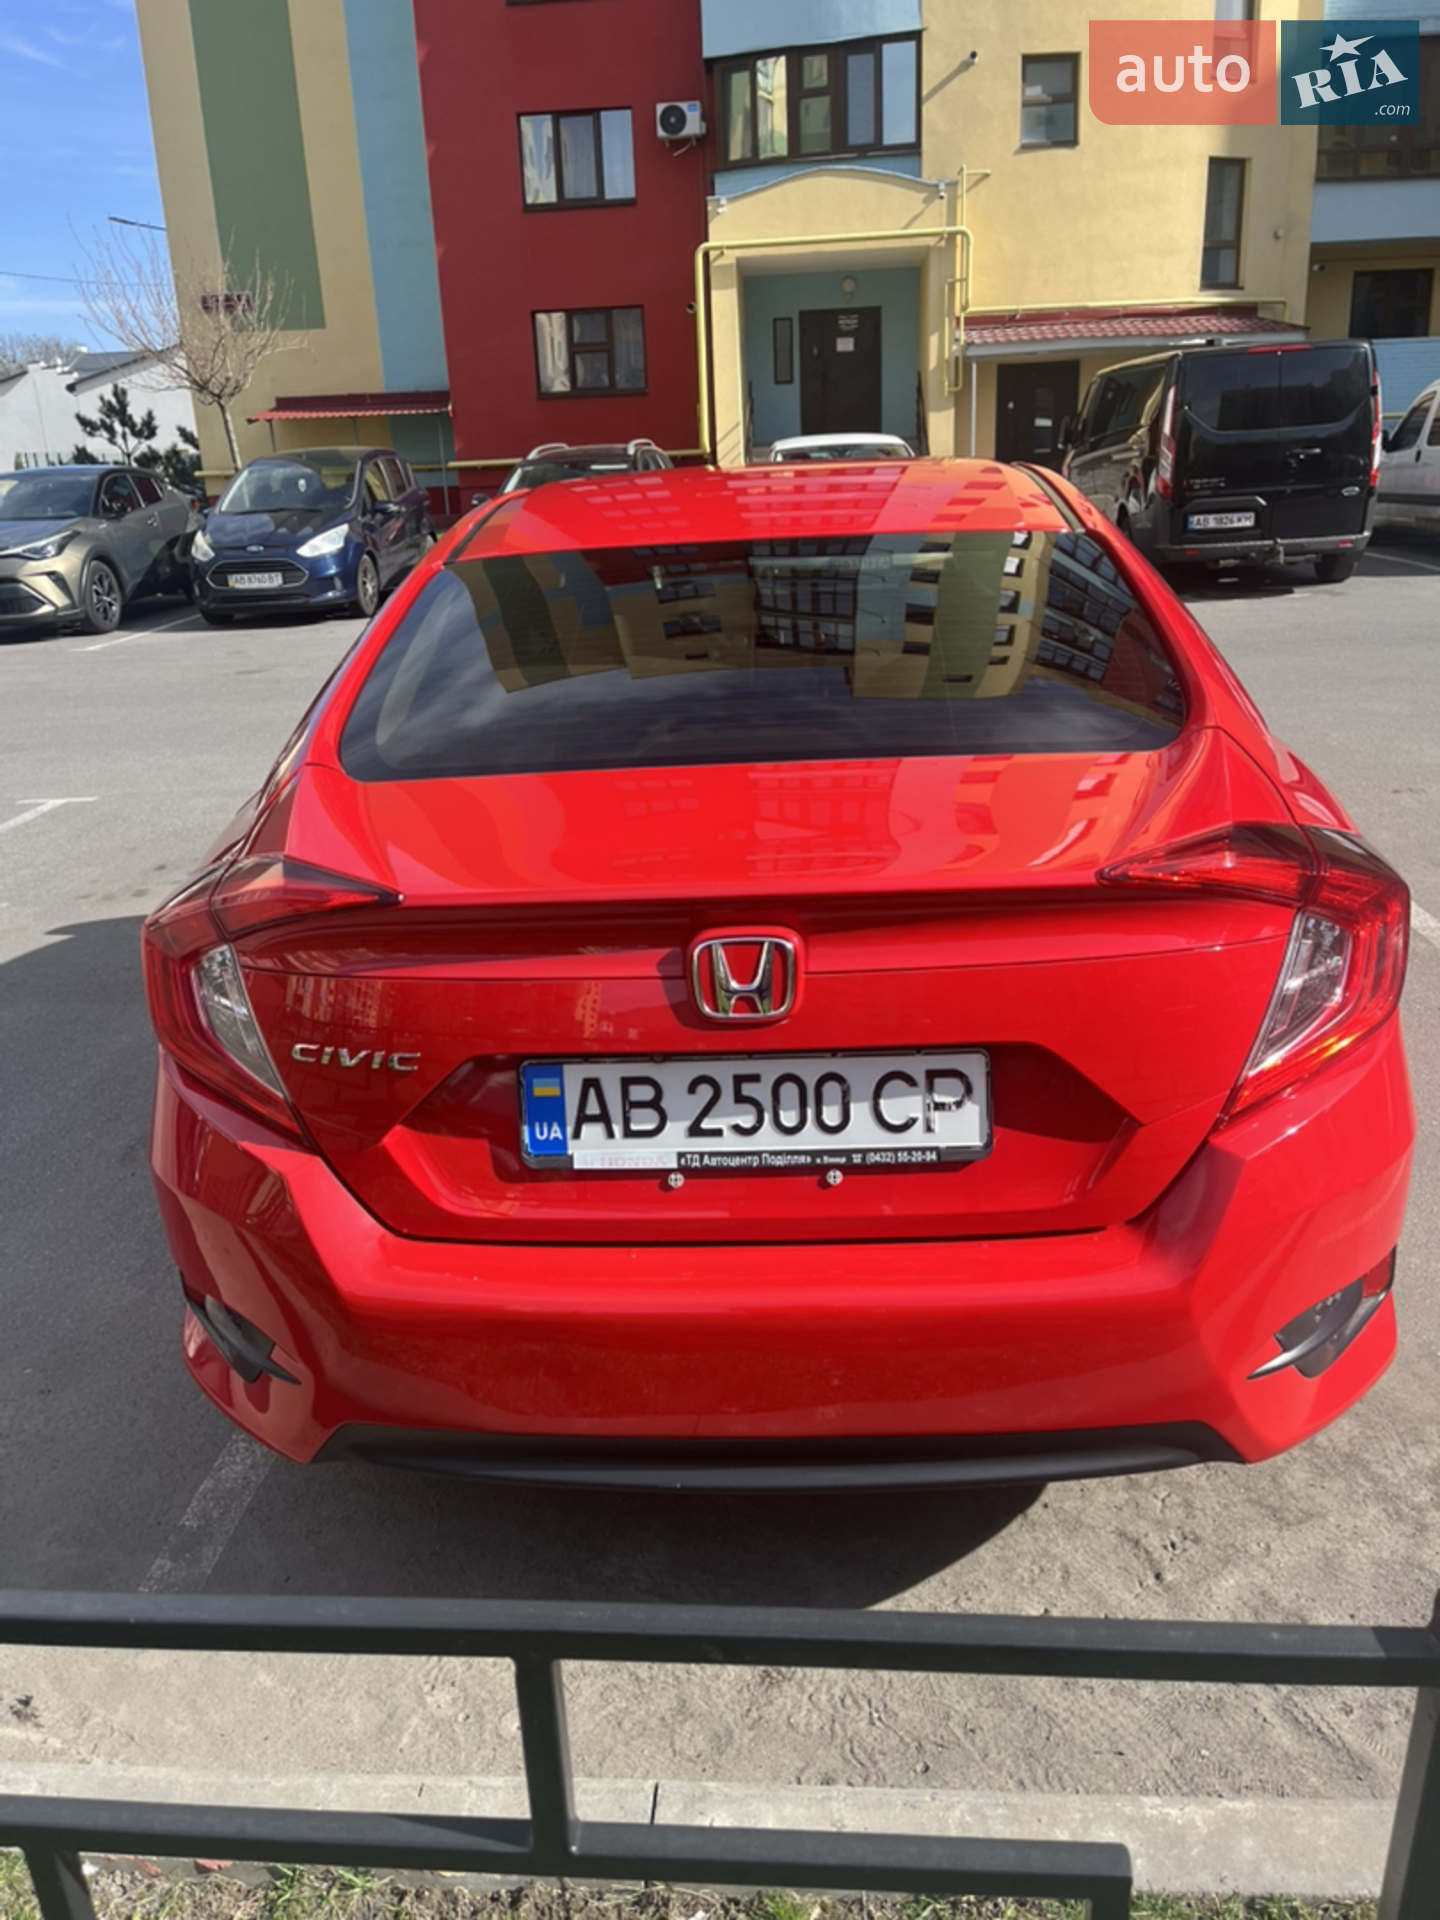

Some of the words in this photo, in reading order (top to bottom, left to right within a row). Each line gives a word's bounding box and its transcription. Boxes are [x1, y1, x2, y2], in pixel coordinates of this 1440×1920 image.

[291, 1043, 421, 1071] CIVIC
[572, 1076, 668, 1140] AB
[686, 1071, 852, 1138] 2500
[871, 1068, 975, 1134] CP
[535, 1121, 563, 1141] UA
[703, 1153, 759, 1170] Автоцентр
